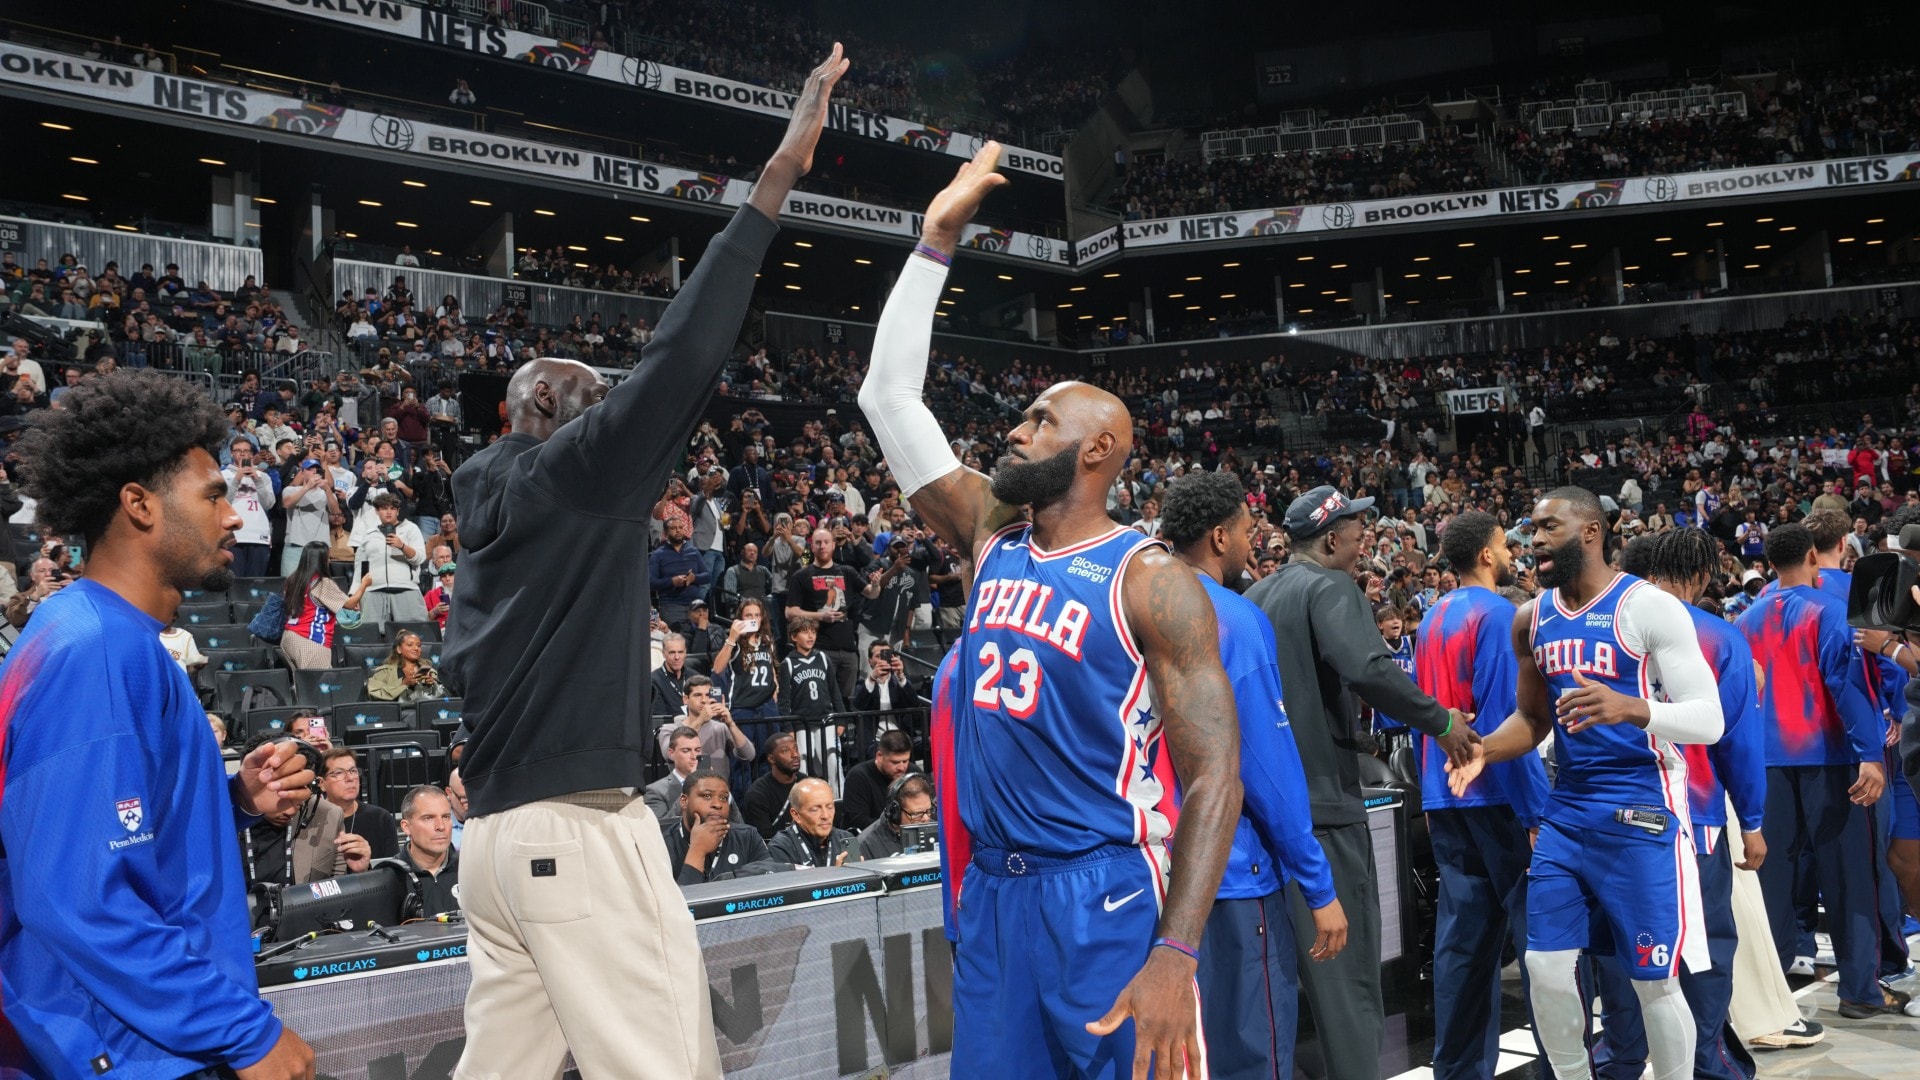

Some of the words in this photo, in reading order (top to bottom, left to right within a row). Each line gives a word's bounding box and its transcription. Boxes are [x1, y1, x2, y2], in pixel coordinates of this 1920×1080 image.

[284, 0, 402, 21] KLYN
[421, 9, 508, 58] NETS
[1, 54, 134, 88] OKLYN
[154, 75, 248, 121] NETS
[1267, 73, 1291, 84] 212
[828, 103, 889, 141] NETS
[428, 136, 580, 168] BROOKLYN
[593, 156, 660, 191] NETS
[1688, 166, 1815, 196] BROOKLYN
[1825, 159, 1890, 185] NETS
[790, 200, 902, 224] BROOKLYN
[1365, 194, 1487, 224] BROOKLYN
[1499, 188, 1560, 213] NETS
[1180, 215, 1239, 241] NETS
[508, 290, 525, 300] 109
[1453, 391, 1501, 412] NETS
[247, 500, 258, 511] 21
[1067, 564, 1109, 584] energy
[1072, 556, 1112, 576] Bloom
[970, 579, 1091, 662] PHILA
[1585, 620, 1612, 628] energy
[1586, 612, 1613, 621] Bloom
[1533, 638, 1620, 679] PHILA
[750, 665, 769, 687] 22
[794, 667, 827, 685] BROOKLYN
[973, 642, 1043, 719] 23
[809, 681, 819, 701] 8
[1370, 796, 1393, 806] BARCLAYS
[109, 840, 130, 850] Penn
[318, 879, 342, 896] NBA
[823, 882, 866, 897] BARCLAYS
[737, 895, 784, 911] BARCLAYS
[1636, 944, 1669, 967] 76
[311, 957, 377, 977] BARCLAYS
